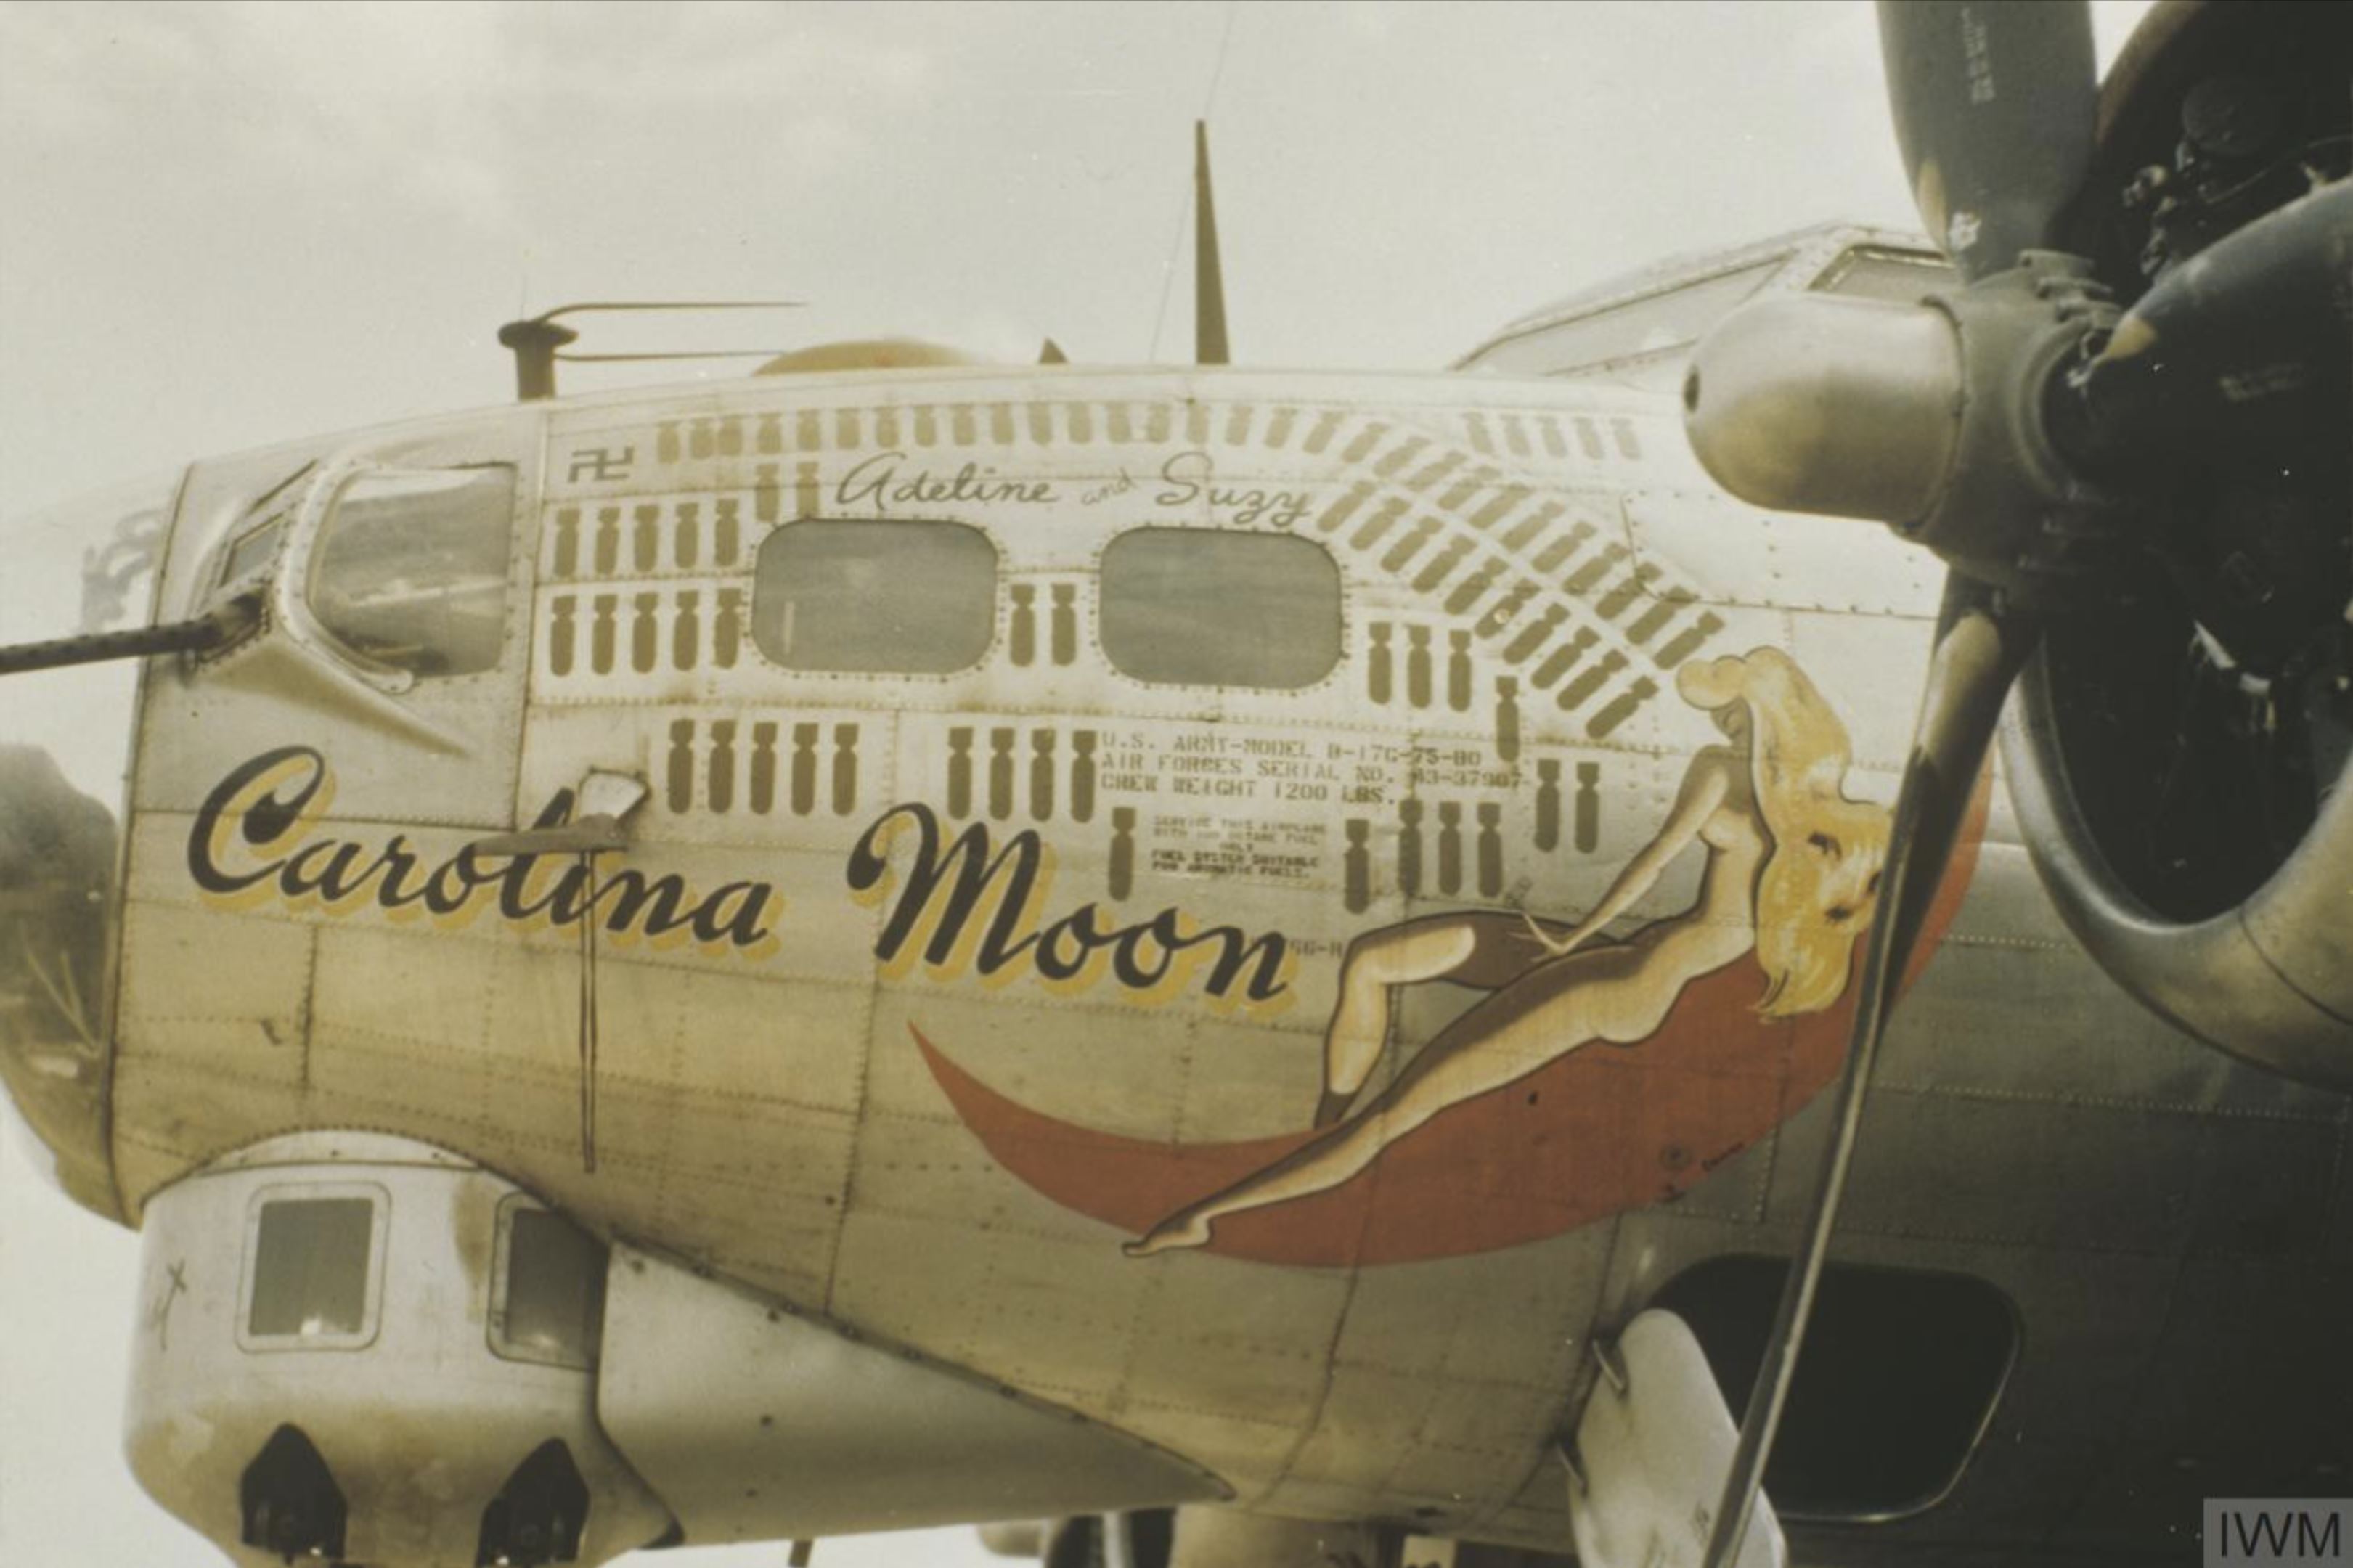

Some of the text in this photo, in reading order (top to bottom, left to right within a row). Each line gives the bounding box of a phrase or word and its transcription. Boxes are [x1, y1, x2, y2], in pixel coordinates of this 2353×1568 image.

[836, 451, 1061, 511] Adeline
[1155, 451, 1313, 526] Suzy
[1101, 730, 1156, 750] U.S.
[1101, 752, 1144, 772] AIR
[1157, 754, 1243, 775] FORCES
[1257, 759, 1340, 780] SERIAL
[1101, 772, 1159, 792] CREW
[1173, 775, 1257, 798] WEIGHT
[1273, 781, 1328, 801] 1200
[187, 745, 1290, 1002] Carolina Moon
